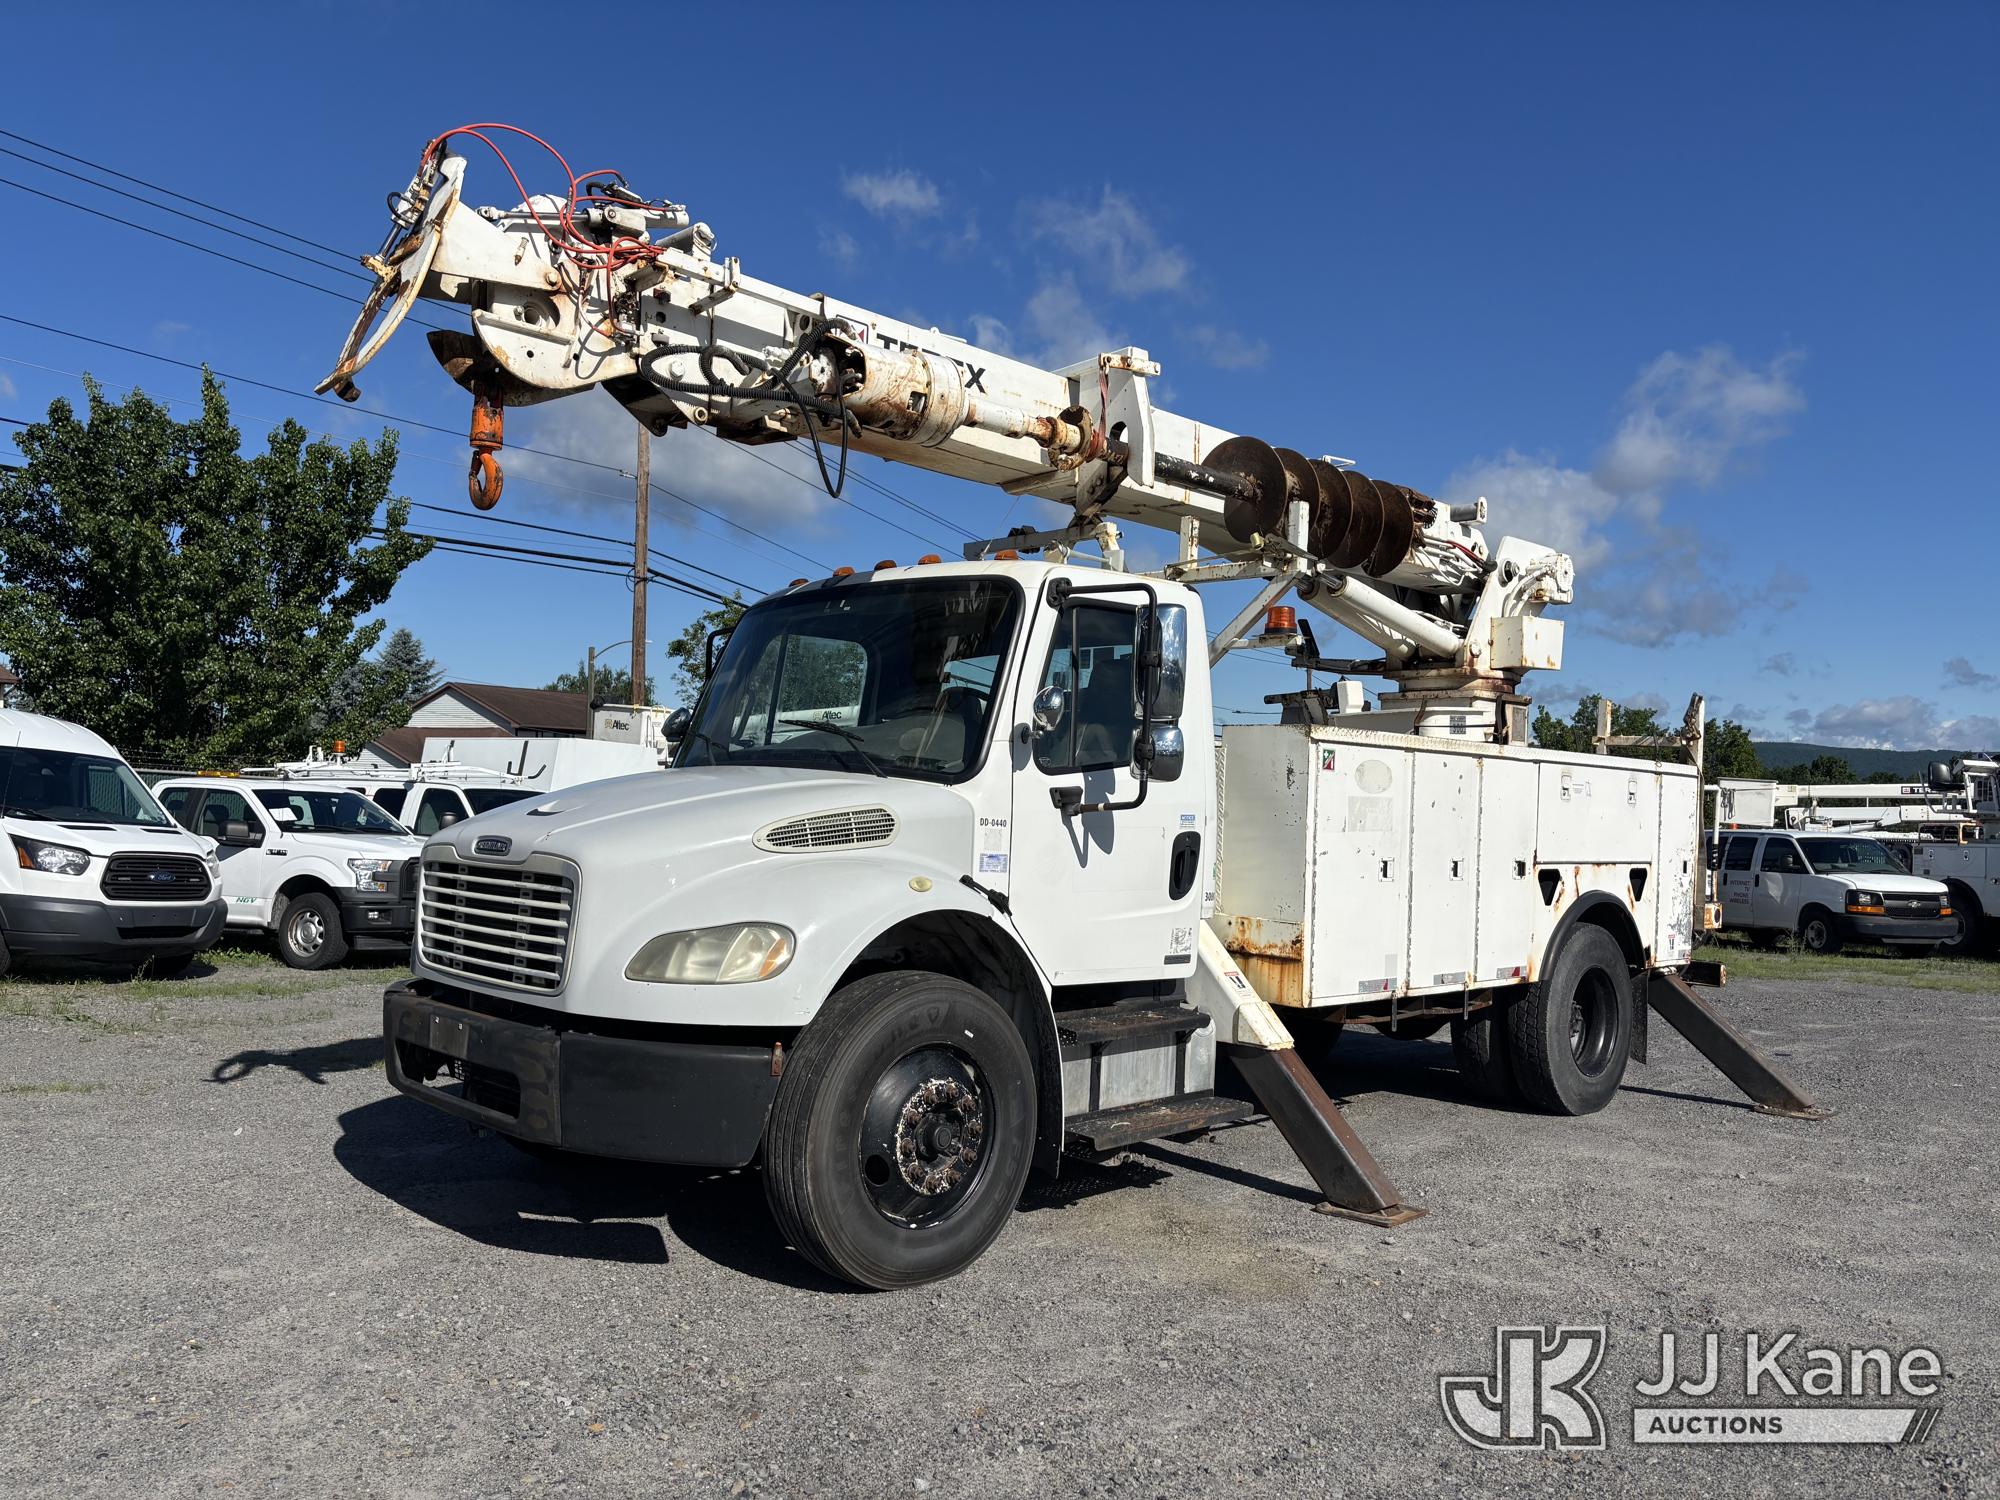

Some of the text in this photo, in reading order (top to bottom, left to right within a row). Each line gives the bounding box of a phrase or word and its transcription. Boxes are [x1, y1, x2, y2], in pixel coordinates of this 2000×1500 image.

[821, 711, 842, 721] Altec
[612, 719, 630, 731] Altec
[980, 817, 1008, 828] DD-0440
